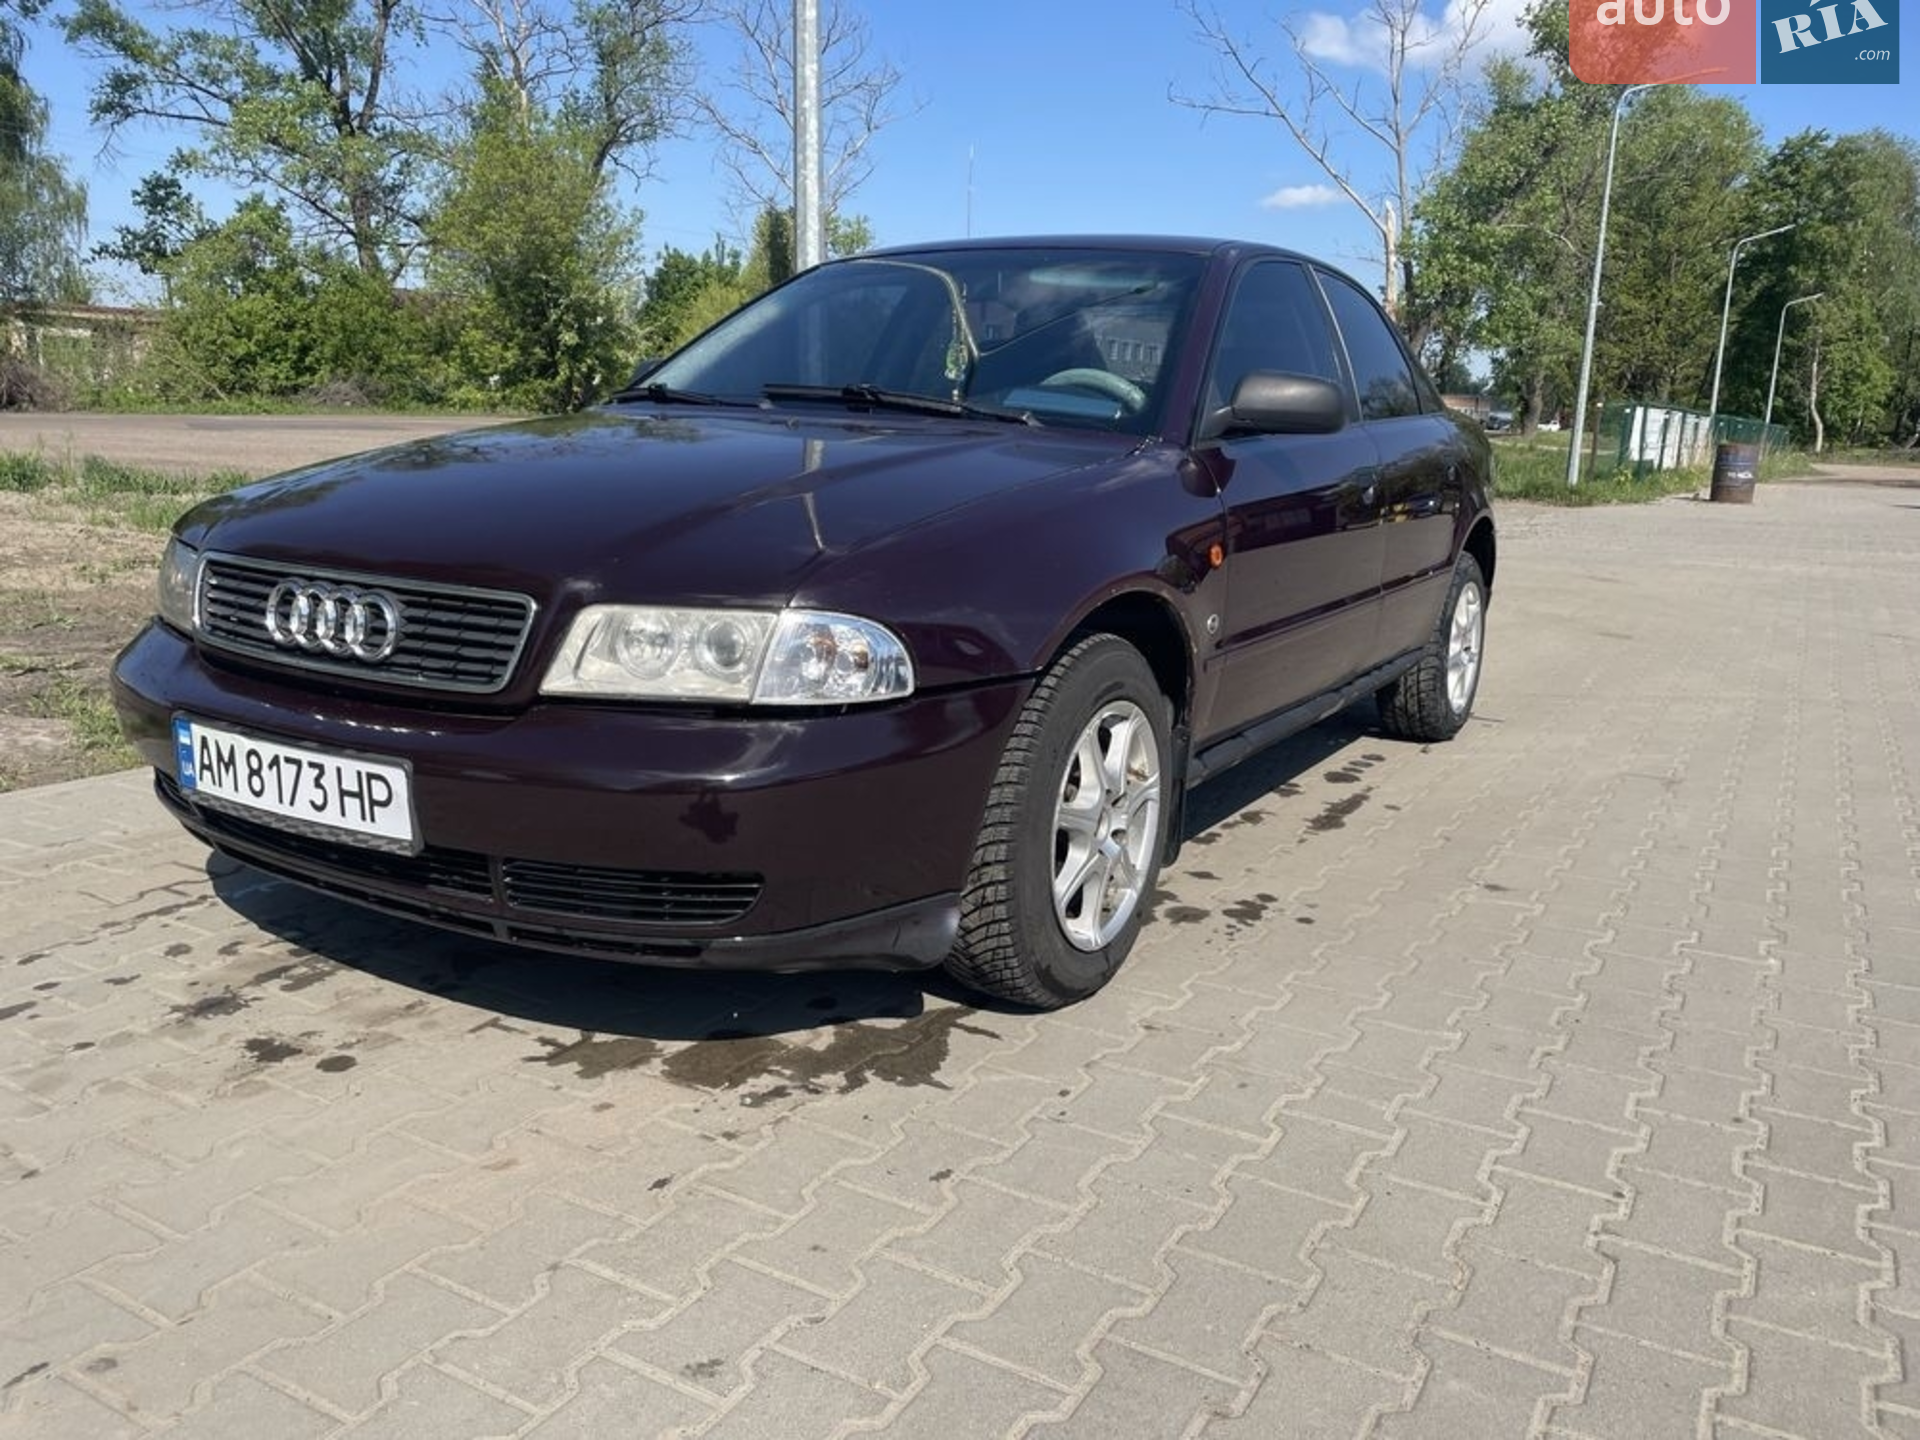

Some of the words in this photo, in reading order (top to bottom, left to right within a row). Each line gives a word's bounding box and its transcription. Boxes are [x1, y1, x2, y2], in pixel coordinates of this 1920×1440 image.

[199, 735, 239, 793] AM
[245, 748, 328, 812] 8173
[336, 766, 393, 823] HP
